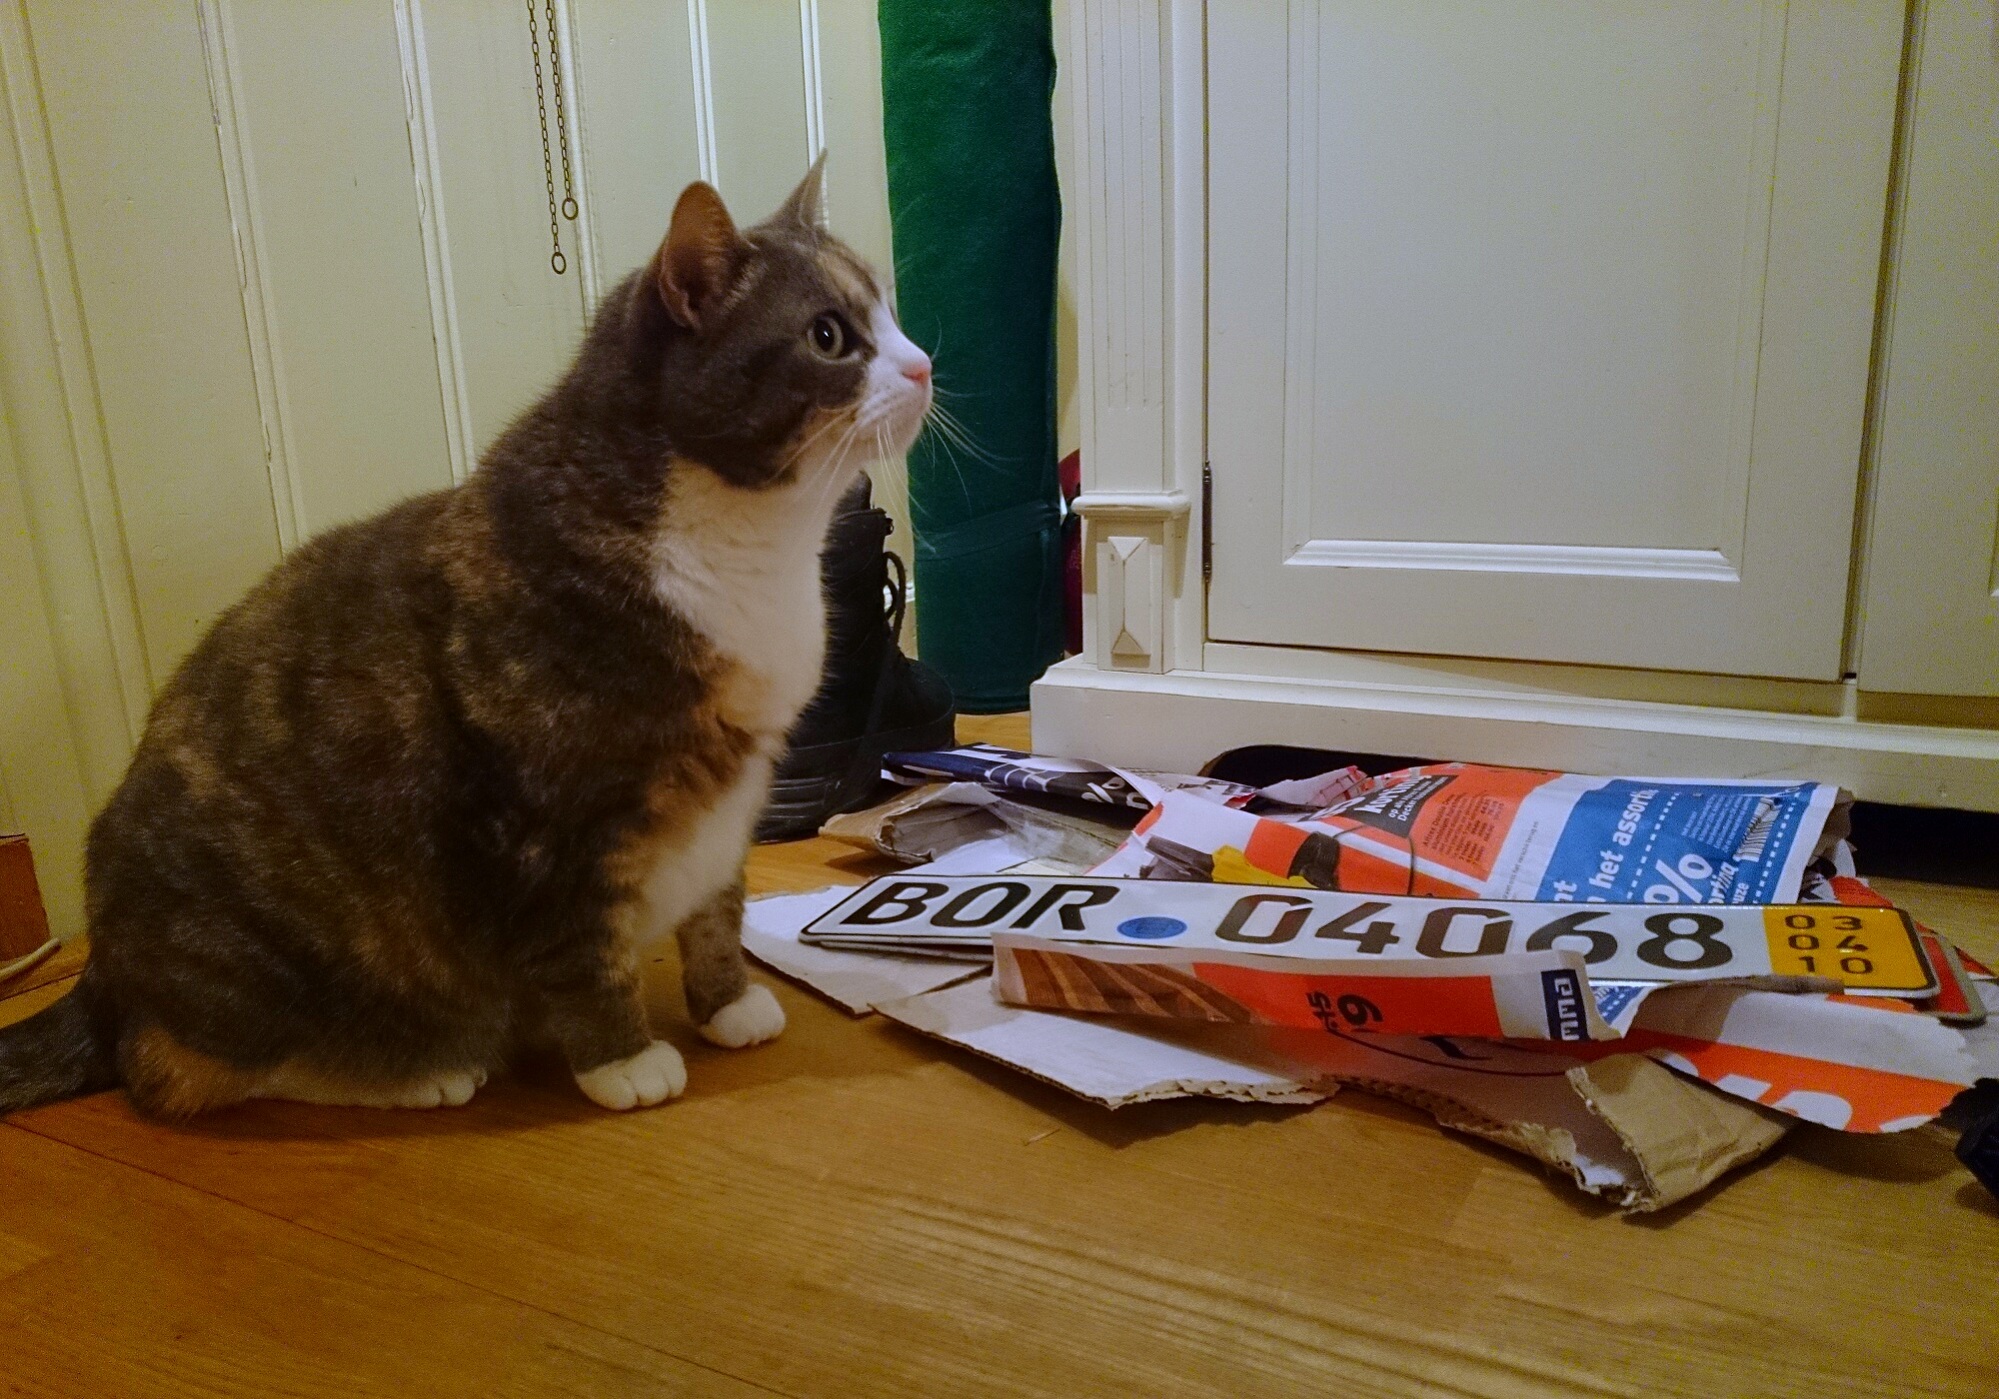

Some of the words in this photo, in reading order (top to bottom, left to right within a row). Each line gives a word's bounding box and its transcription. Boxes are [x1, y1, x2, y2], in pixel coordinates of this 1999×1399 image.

[1588, 848, 1625, 890] het
[839, 881, 1121, 932] BOR
[1214, 893, 1735, 970] 04068
[1784, 913, 1864, 931] 03
[1787, 934, 1869, 952] 04
[1798, 955, 1874, 975] 10
